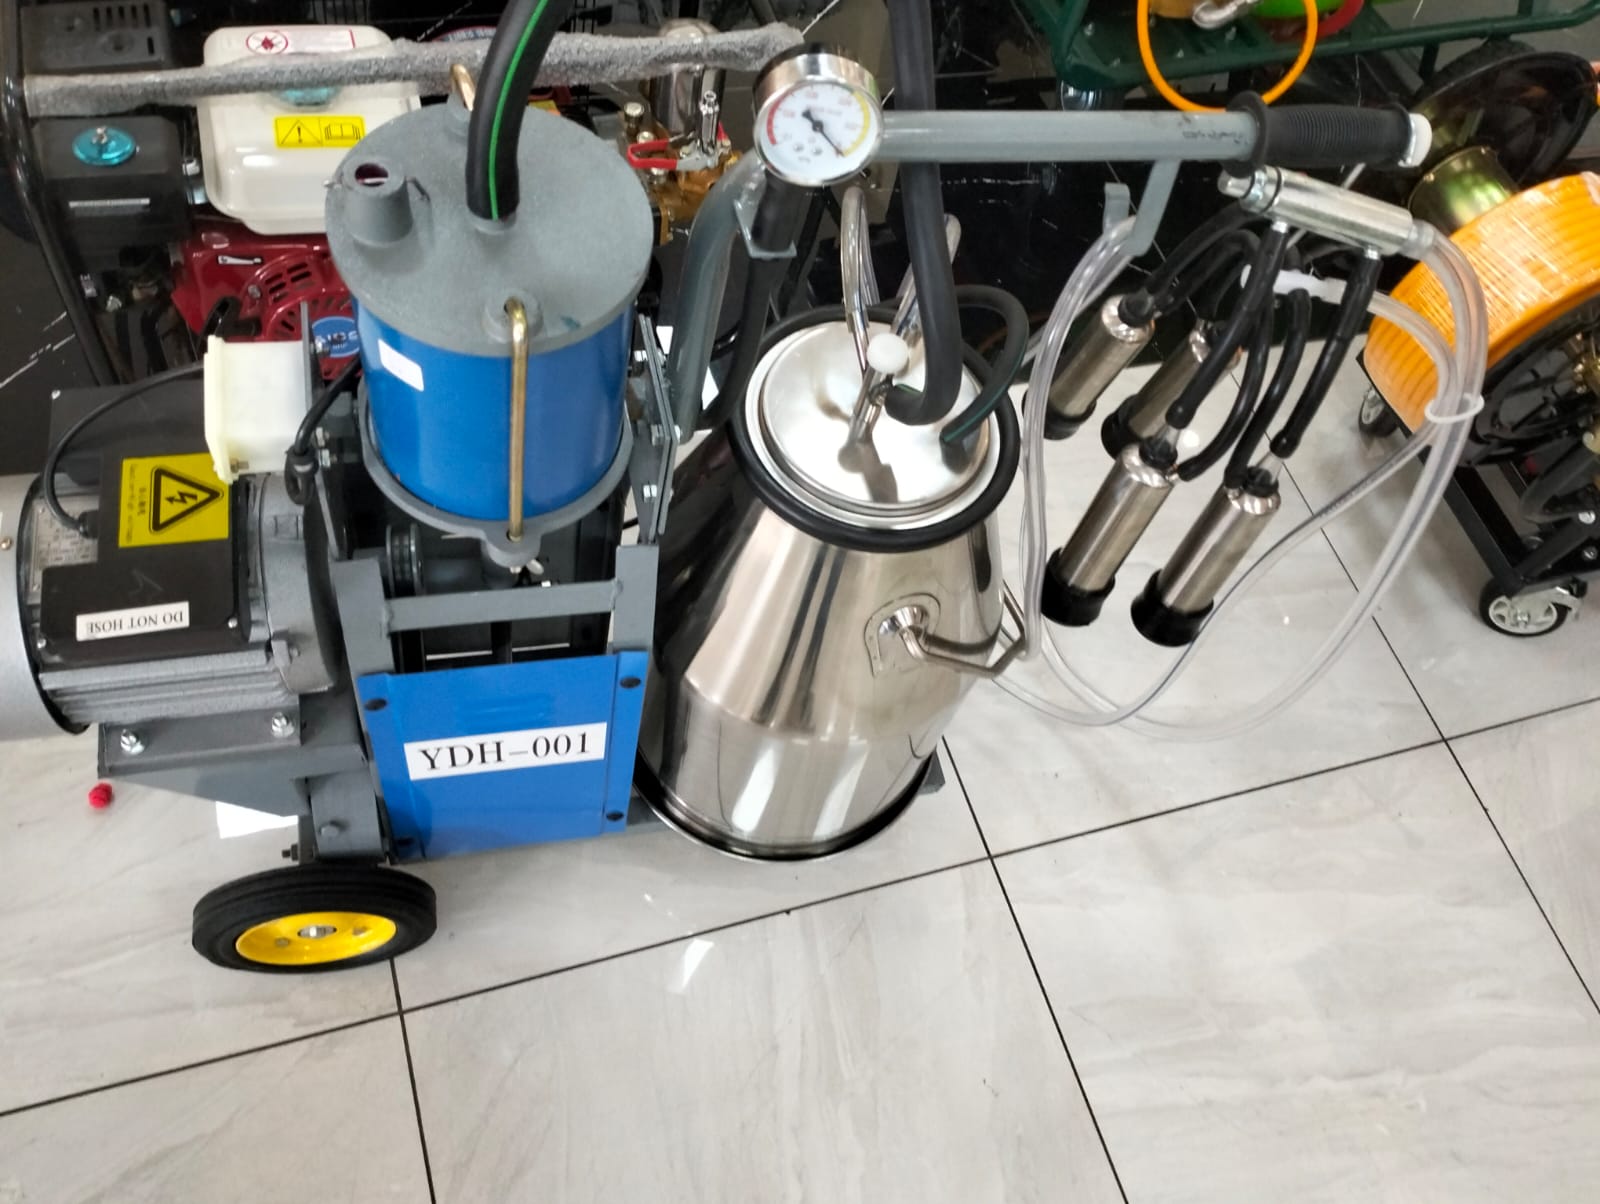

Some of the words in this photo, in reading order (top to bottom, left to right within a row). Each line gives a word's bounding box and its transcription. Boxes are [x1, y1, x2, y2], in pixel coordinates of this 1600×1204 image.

[128, 614, 158, 630] NOT
[162, 610, 183, 624] DO
[418, 731, 590, 771] YDH-001
